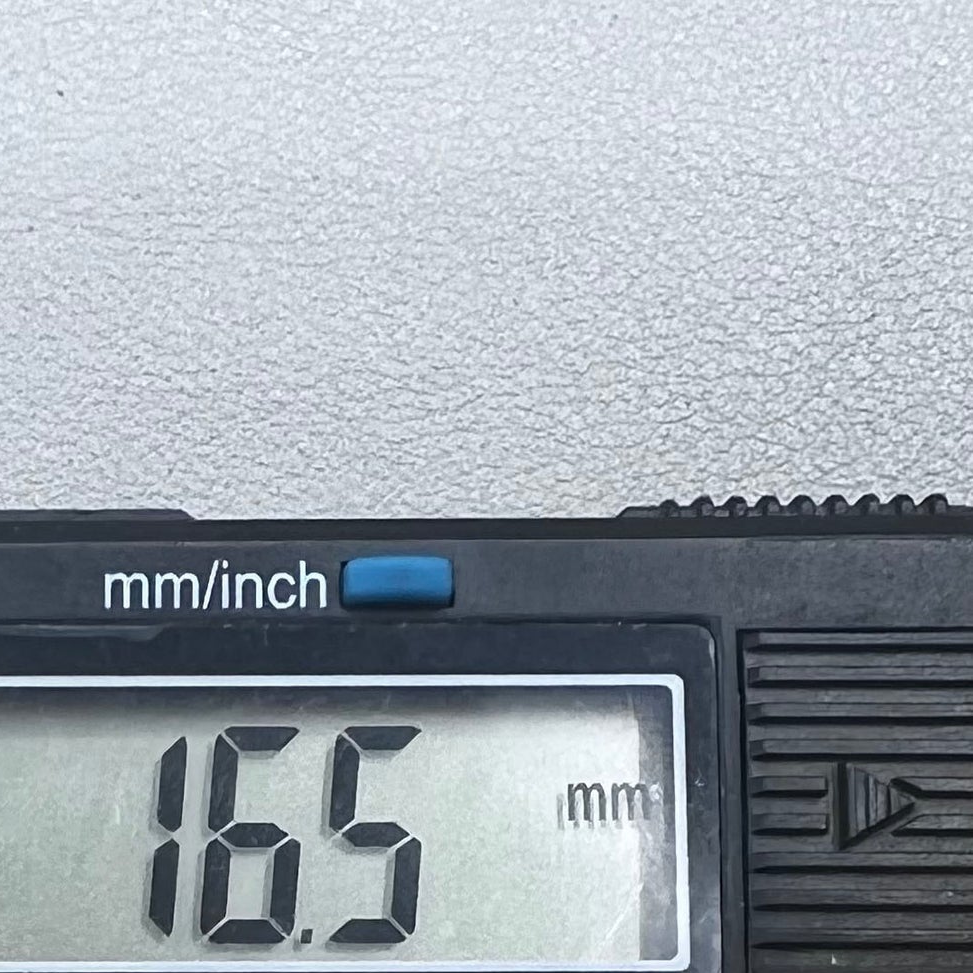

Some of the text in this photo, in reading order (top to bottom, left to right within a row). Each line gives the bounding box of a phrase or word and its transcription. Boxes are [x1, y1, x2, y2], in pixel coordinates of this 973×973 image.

[104, 559, 327, 609] mm/inch
[146, 724, 651, 945] 16.5 mm
